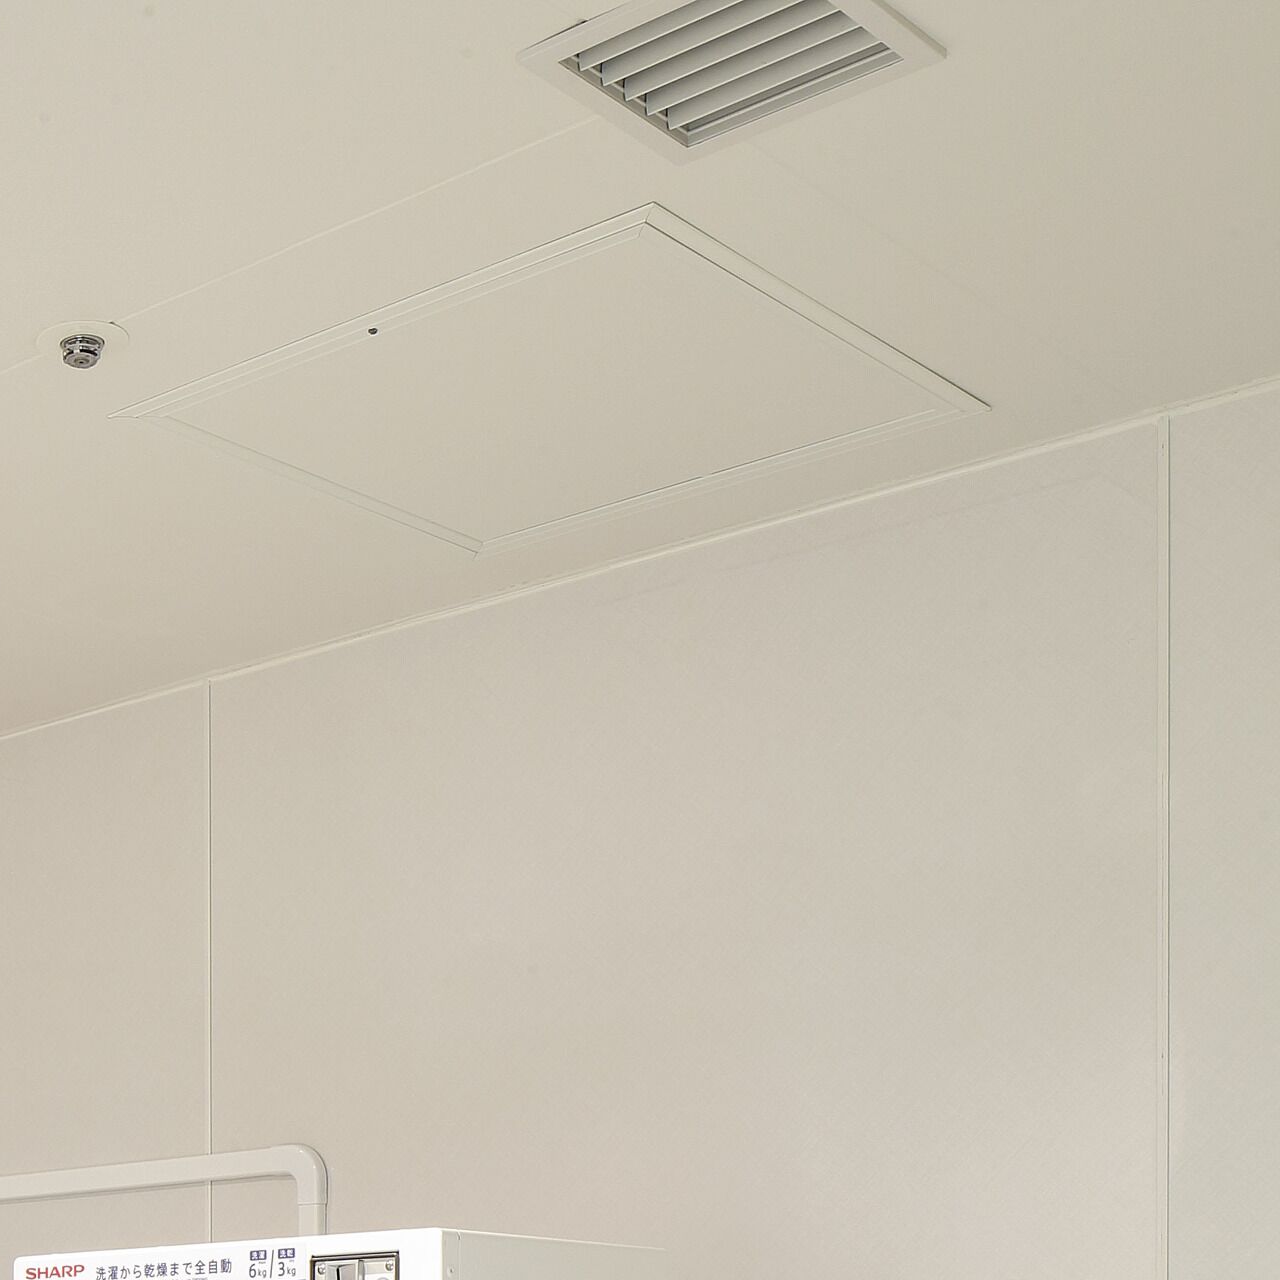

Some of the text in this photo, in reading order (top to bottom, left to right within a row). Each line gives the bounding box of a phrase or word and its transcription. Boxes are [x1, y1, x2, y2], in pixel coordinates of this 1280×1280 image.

[25, 1264, 85, 1280] SHARP
[96, 1258, 232, 1280] 洗濯から乾燥まで全自動
[249, 1263, 266, 1278] 6kg
[278, 1262, 296, 1277] 3kg
